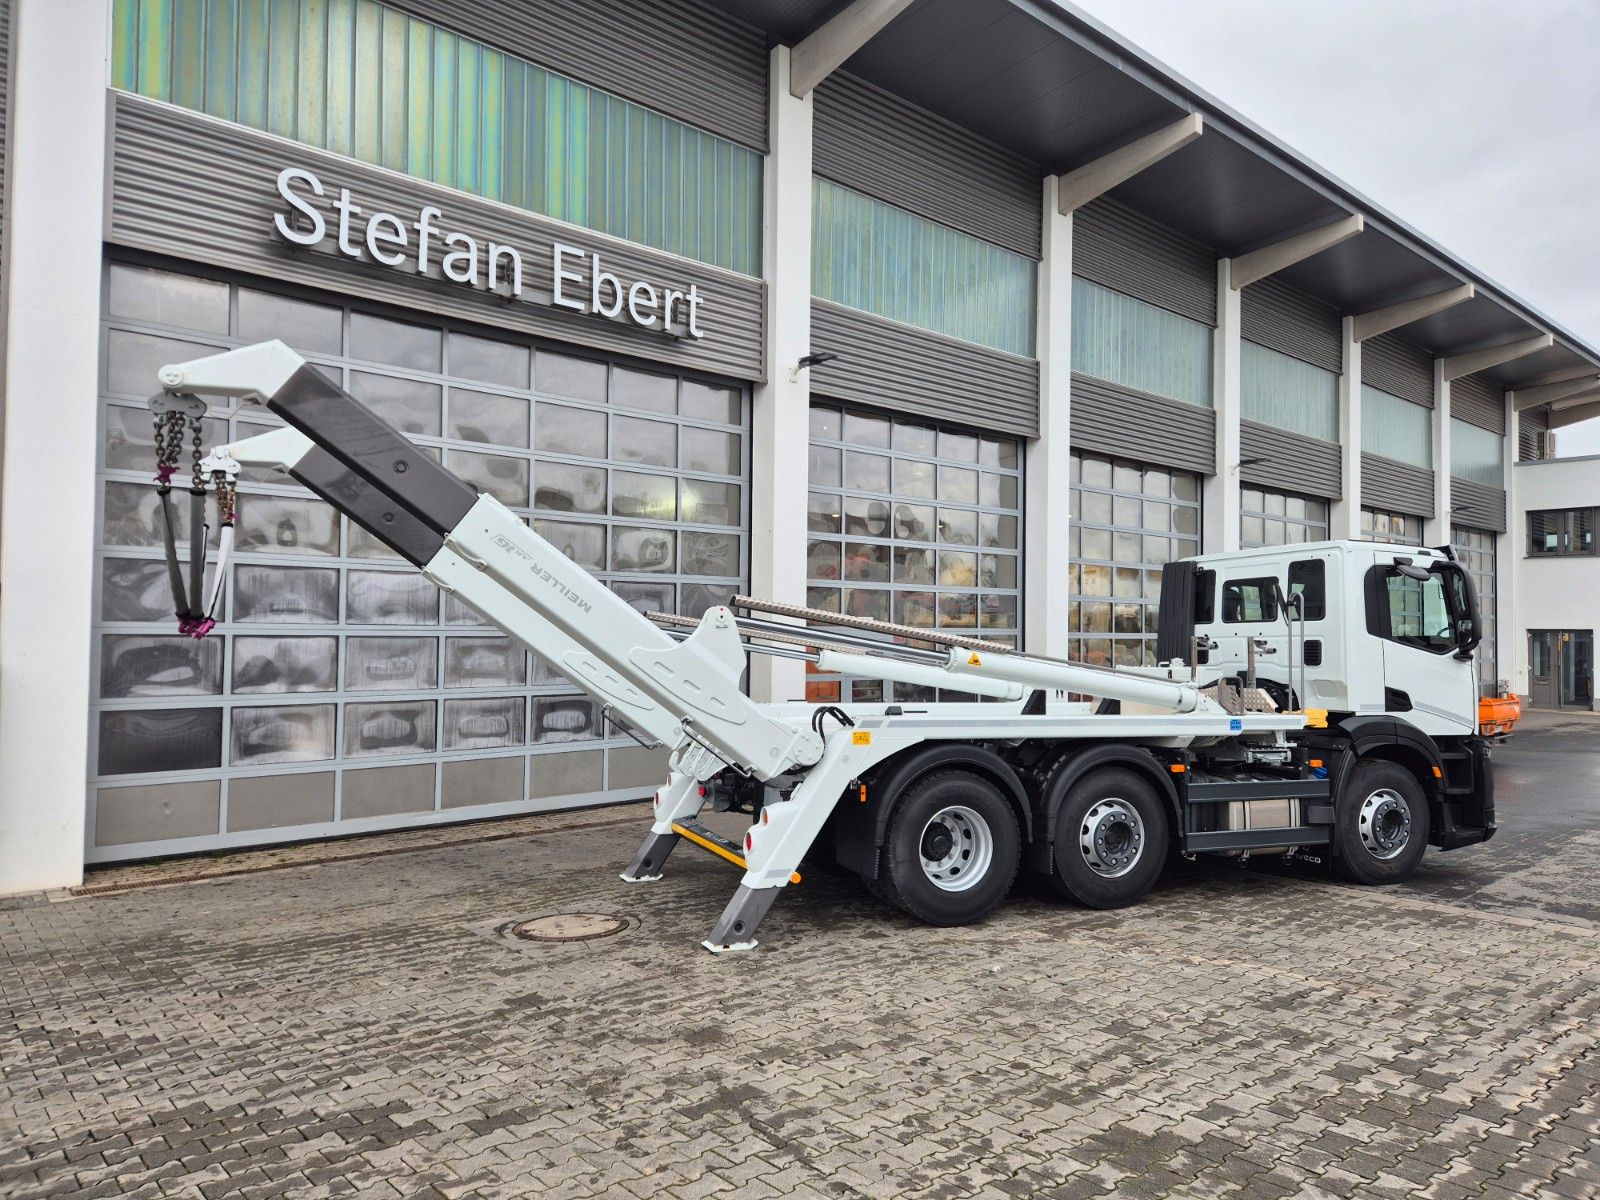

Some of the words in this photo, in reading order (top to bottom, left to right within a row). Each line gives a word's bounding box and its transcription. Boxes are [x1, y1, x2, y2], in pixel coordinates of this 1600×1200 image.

[274, 167, 522, 296] Stefan
[553, 241, 704, 338] Ebert
[530, 562, 592, 613] MEILLER
